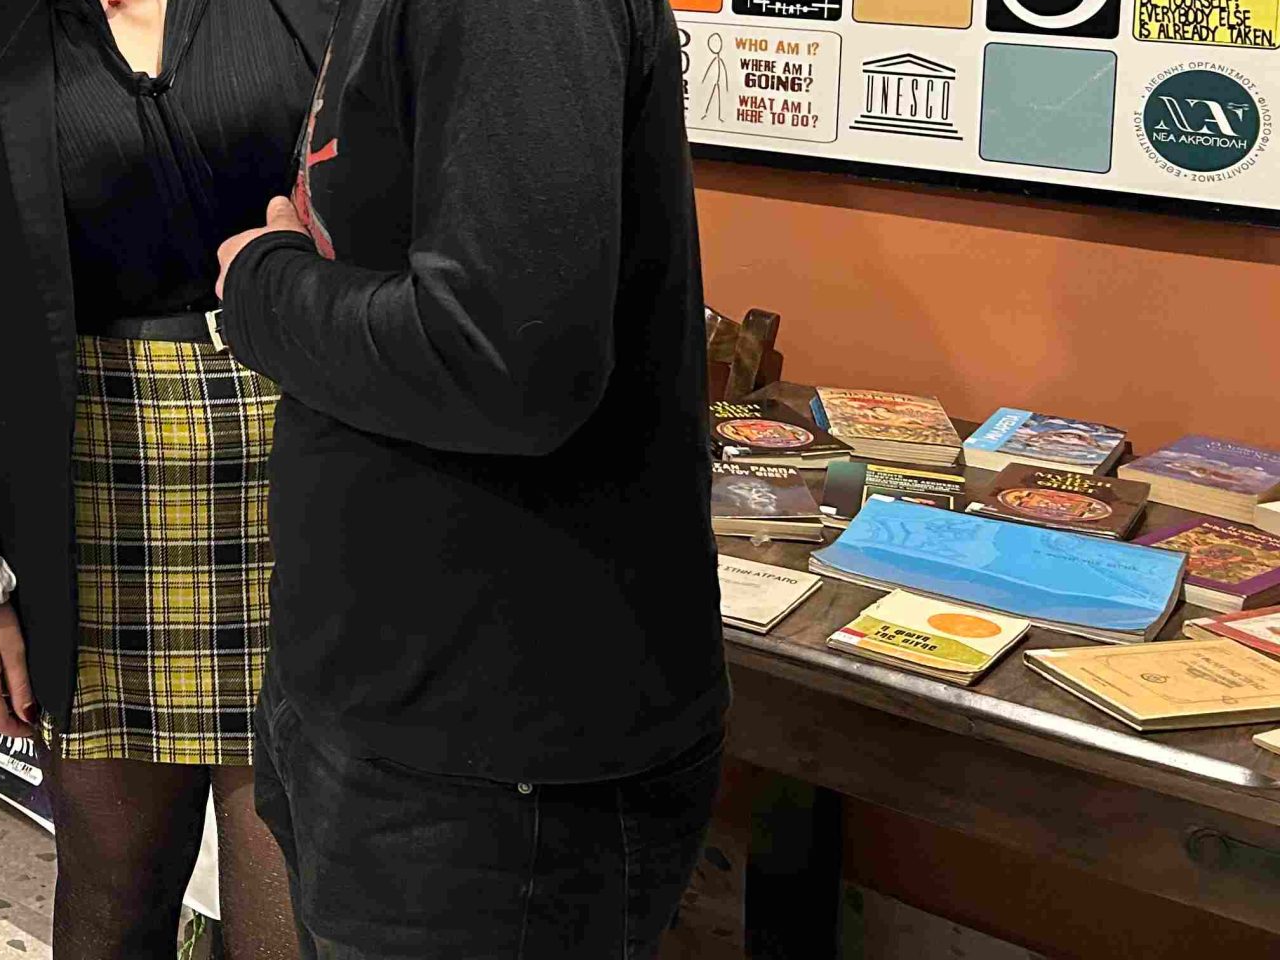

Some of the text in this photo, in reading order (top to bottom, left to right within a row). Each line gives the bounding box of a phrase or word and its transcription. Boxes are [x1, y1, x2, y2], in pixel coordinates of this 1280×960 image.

[1139, 5, 1252, 29] EVERYBODY ELSE
[1139, 20, 1152, 39] IS
[1158, 23, 1218, 40] ALREADY
[735, 37, 820, 56] WHO AM I?
[740, 58, 813, 76] WHERE AM I
[738, 95, 812, 115] WHAT AM I
[865, 75, 951, 121] UNESCO
[736, 108, 819, 129] HERE TO DO?
[1133, 61, 1272, 183] ΔΙΕΘΝΗΣ ΟΡΓΑΝΙΣΜΟΣ ΦΙΛΟΣΟΦΙΑ ΠΟΛΙΤΙΣΜΟΣ ΕΘΕΛΟΝΤΙΣΜΟΣ
[1179, 134, 1247, 149] ΑΚΡΟΠΟΛΗ
